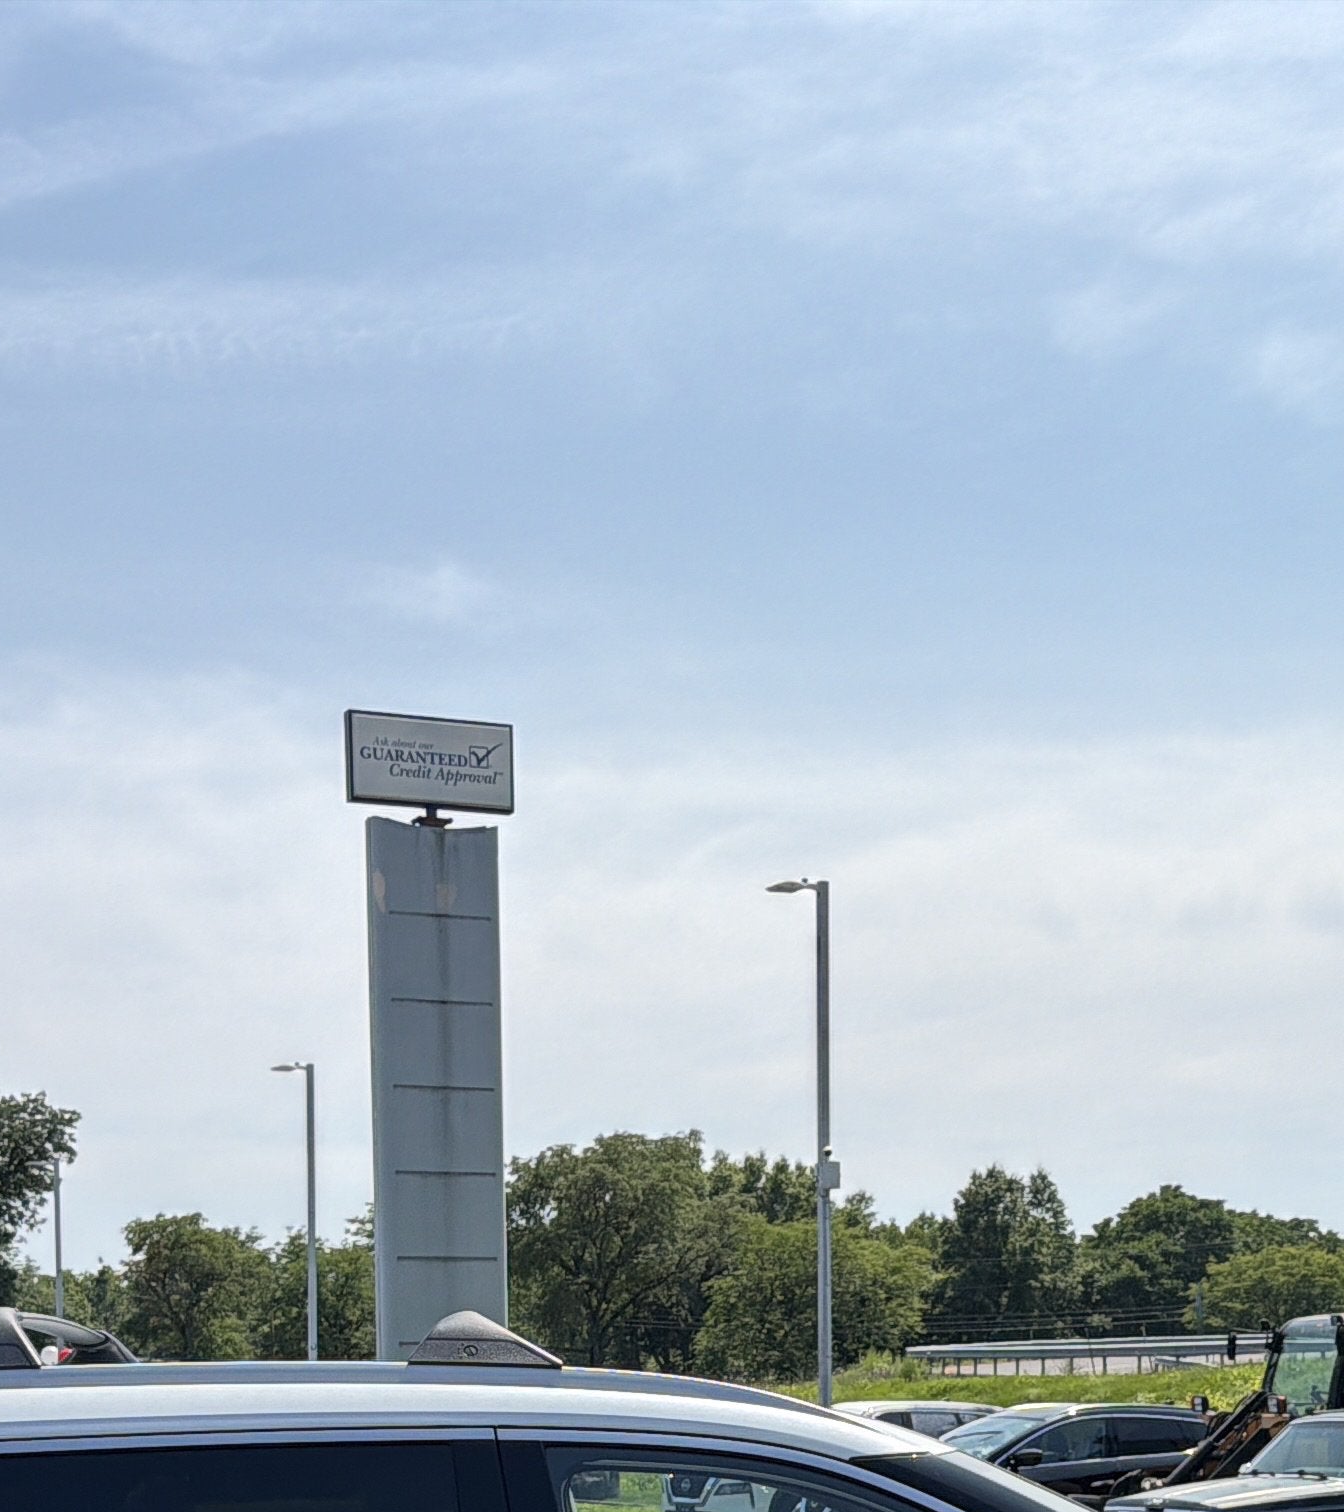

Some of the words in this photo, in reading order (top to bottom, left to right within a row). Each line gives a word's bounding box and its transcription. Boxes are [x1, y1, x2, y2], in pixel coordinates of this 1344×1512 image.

[372, 736, 388, 747] Ask
[391, 739, 416, 749] about
[418, 742, 434, 750] our
[359, 746, 468, 767] GUARANTEED
[389, 764, 432, 780] Credit
